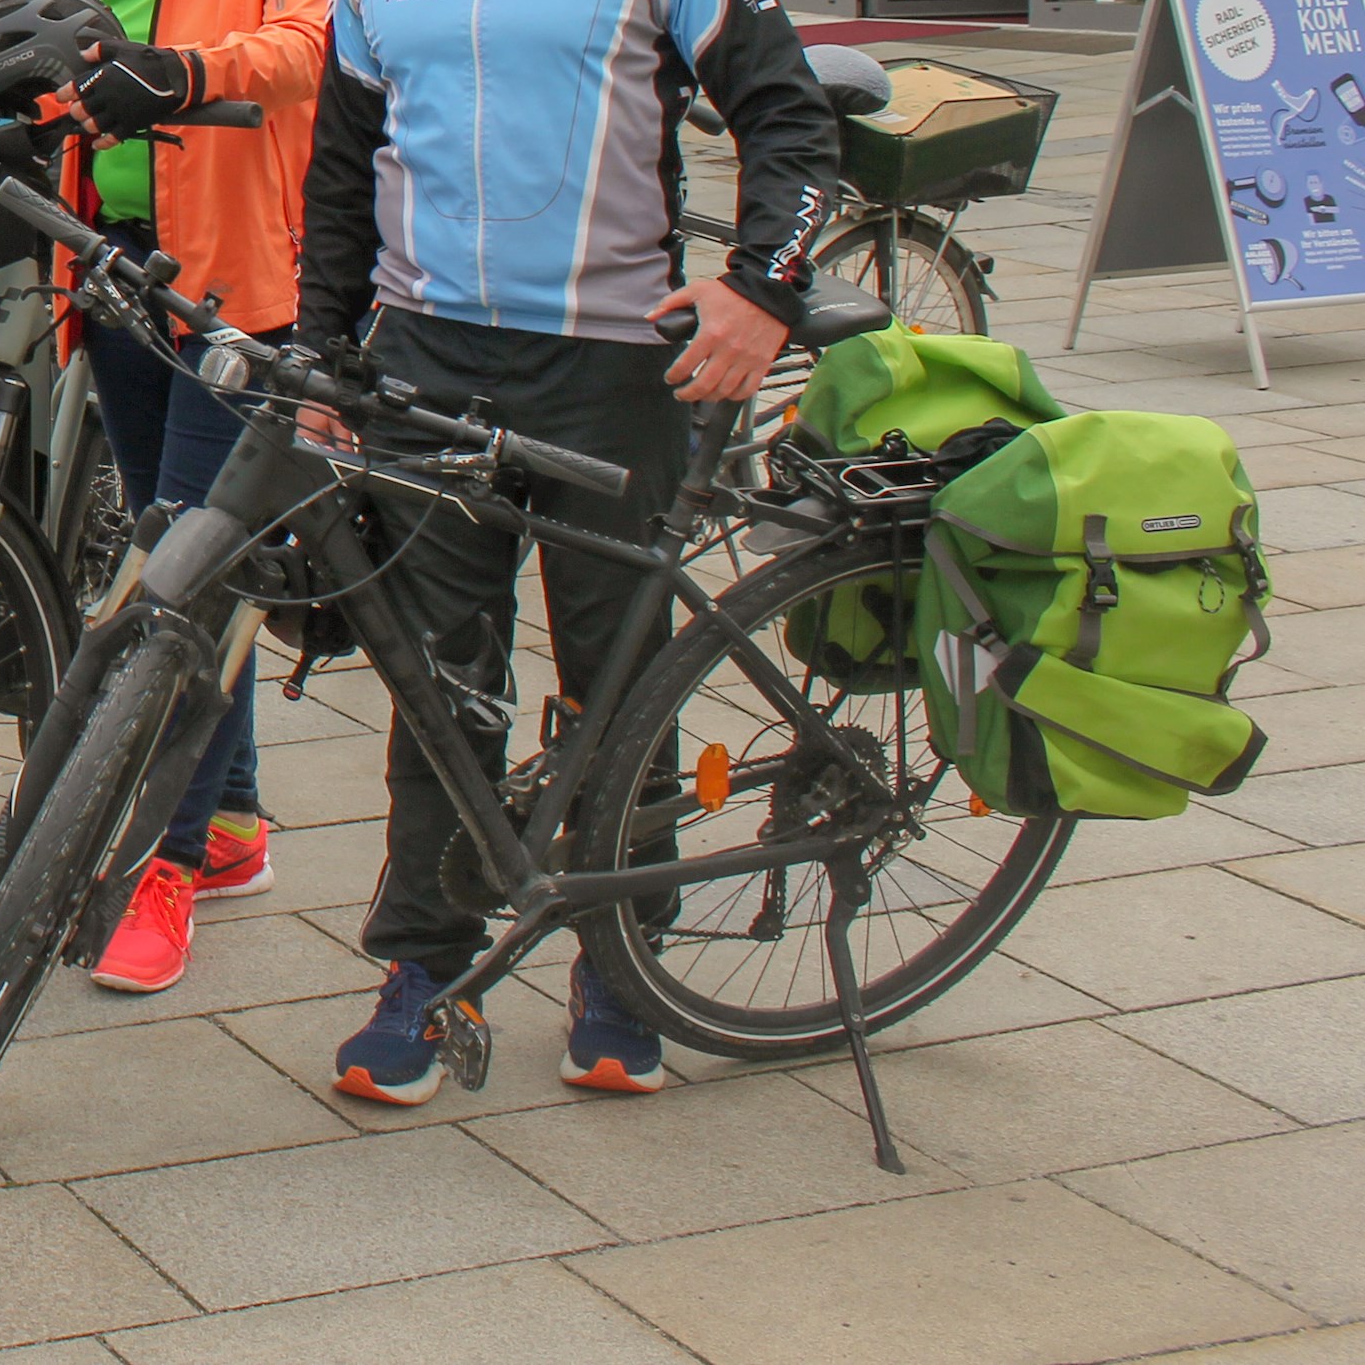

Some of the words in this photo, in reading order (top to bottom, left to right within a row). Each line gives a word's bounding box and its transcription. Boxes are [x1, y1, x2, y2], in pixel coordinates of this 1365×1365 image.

[1215, 6, 1244, 25] RADL-
[1297, 7, 1348, 32] KOM
[1205, 15, 1266, 48] SICHERHEITS
[1302, 30, 1362, 56] MEN!
[1226, 37, 1260, 59] CHECK
[1144, 520, 1175, 529] ORTLIEB
